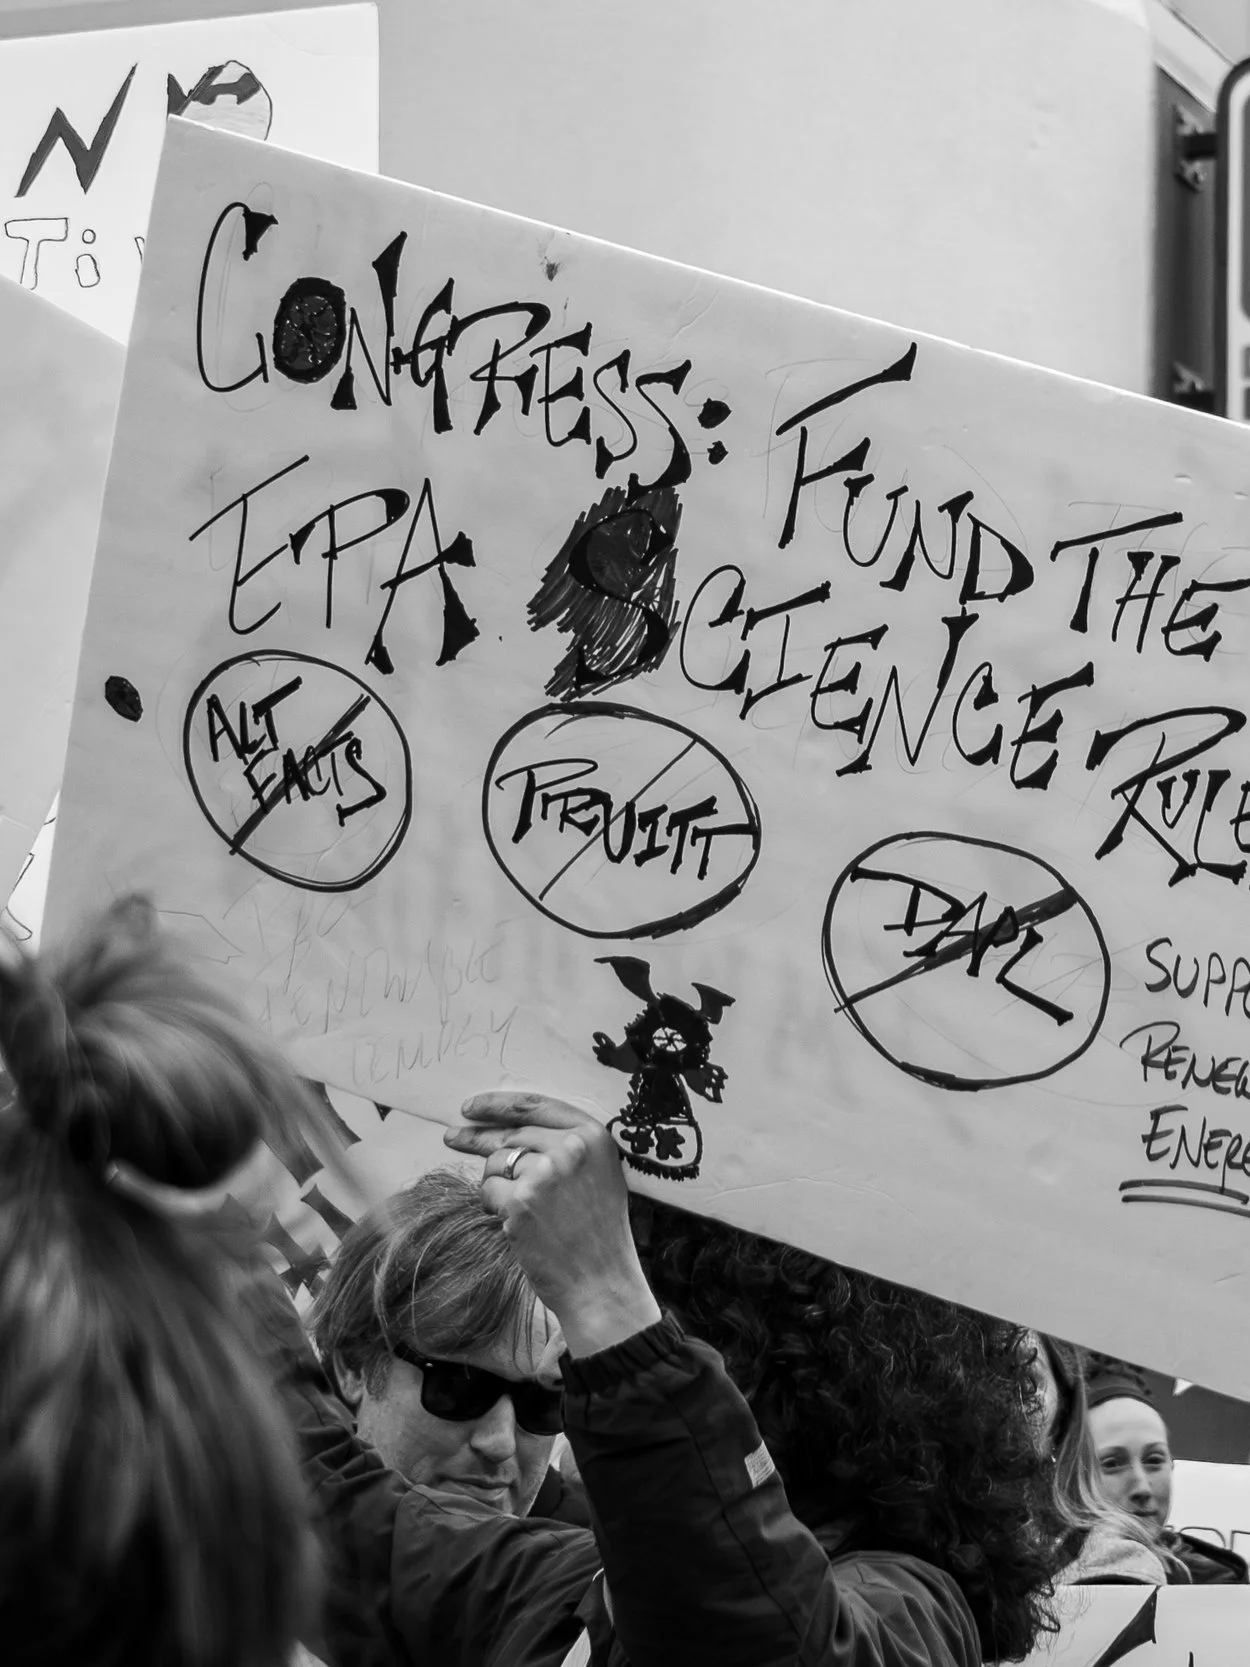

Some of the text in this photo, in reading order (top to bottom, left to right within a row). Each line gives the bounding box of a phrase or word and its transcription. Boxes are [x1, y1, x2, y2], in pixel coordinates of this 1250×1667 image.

[776, 343, 1034, 605] FUND
[189, 456, 479, 673] EPA
[206, 676, 303, 765] ALT
[496, 759, 752, 880] PRUITT
[851, 866, 1074, 1026] DAPL
